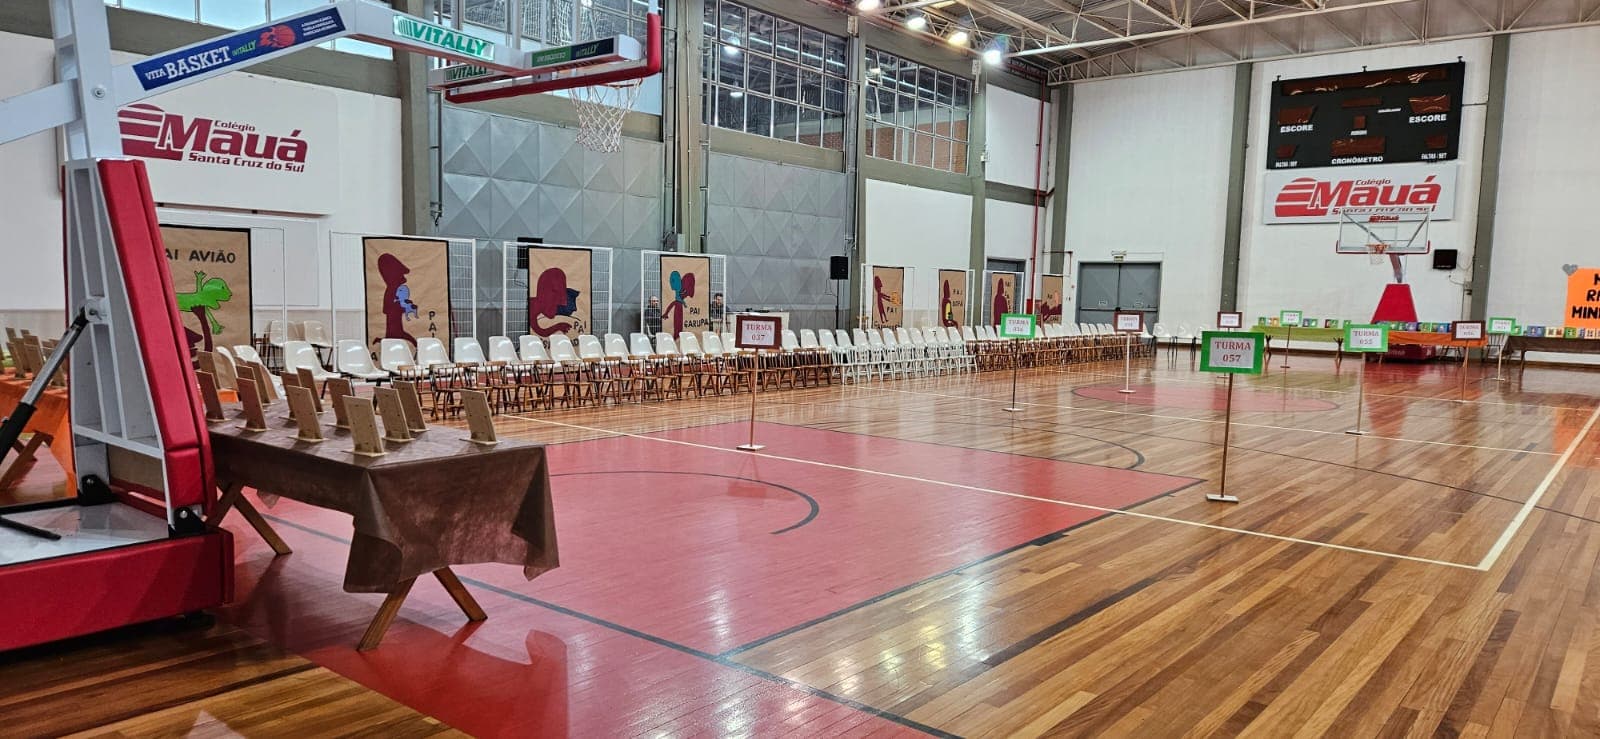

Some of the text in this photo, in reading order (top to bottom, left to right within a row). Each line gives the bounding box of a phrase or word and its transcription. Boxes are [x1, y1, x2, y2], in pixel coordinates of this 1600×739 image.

[411, 19, 488, 57] VITALLY
[145, 69, 166, 81] VITA
[167, 46, 230, 80] BASKET
[451, 65, 488, 80] VITALLY
[1408, 114, 1447, 123] ESCORE
[214, 119, 256, 132] Colégio
[1280, 124, 1313, 133] ESCORE
[157, 112, 308, 163] Mauá
[188, 152, 305, 173] Santa Cruz do Sul
[1331, 155, 1383, 165] CRONÔMETRO
[1307, 175, 1441, 209] Mauá
[165, 248, 236, 264] AI AVIÃO
[690, 307, 701, 315] PAI
[1571, 305, 1600, 319] MIN
[574, 321, 588, 334] PAI
[684, 318, 710, 328] GARUPA
[746, 323, 772, 331] TURMA
[1215, 341, 1251, 351] TURMA
[1222, 354, 1242, 363] 057
